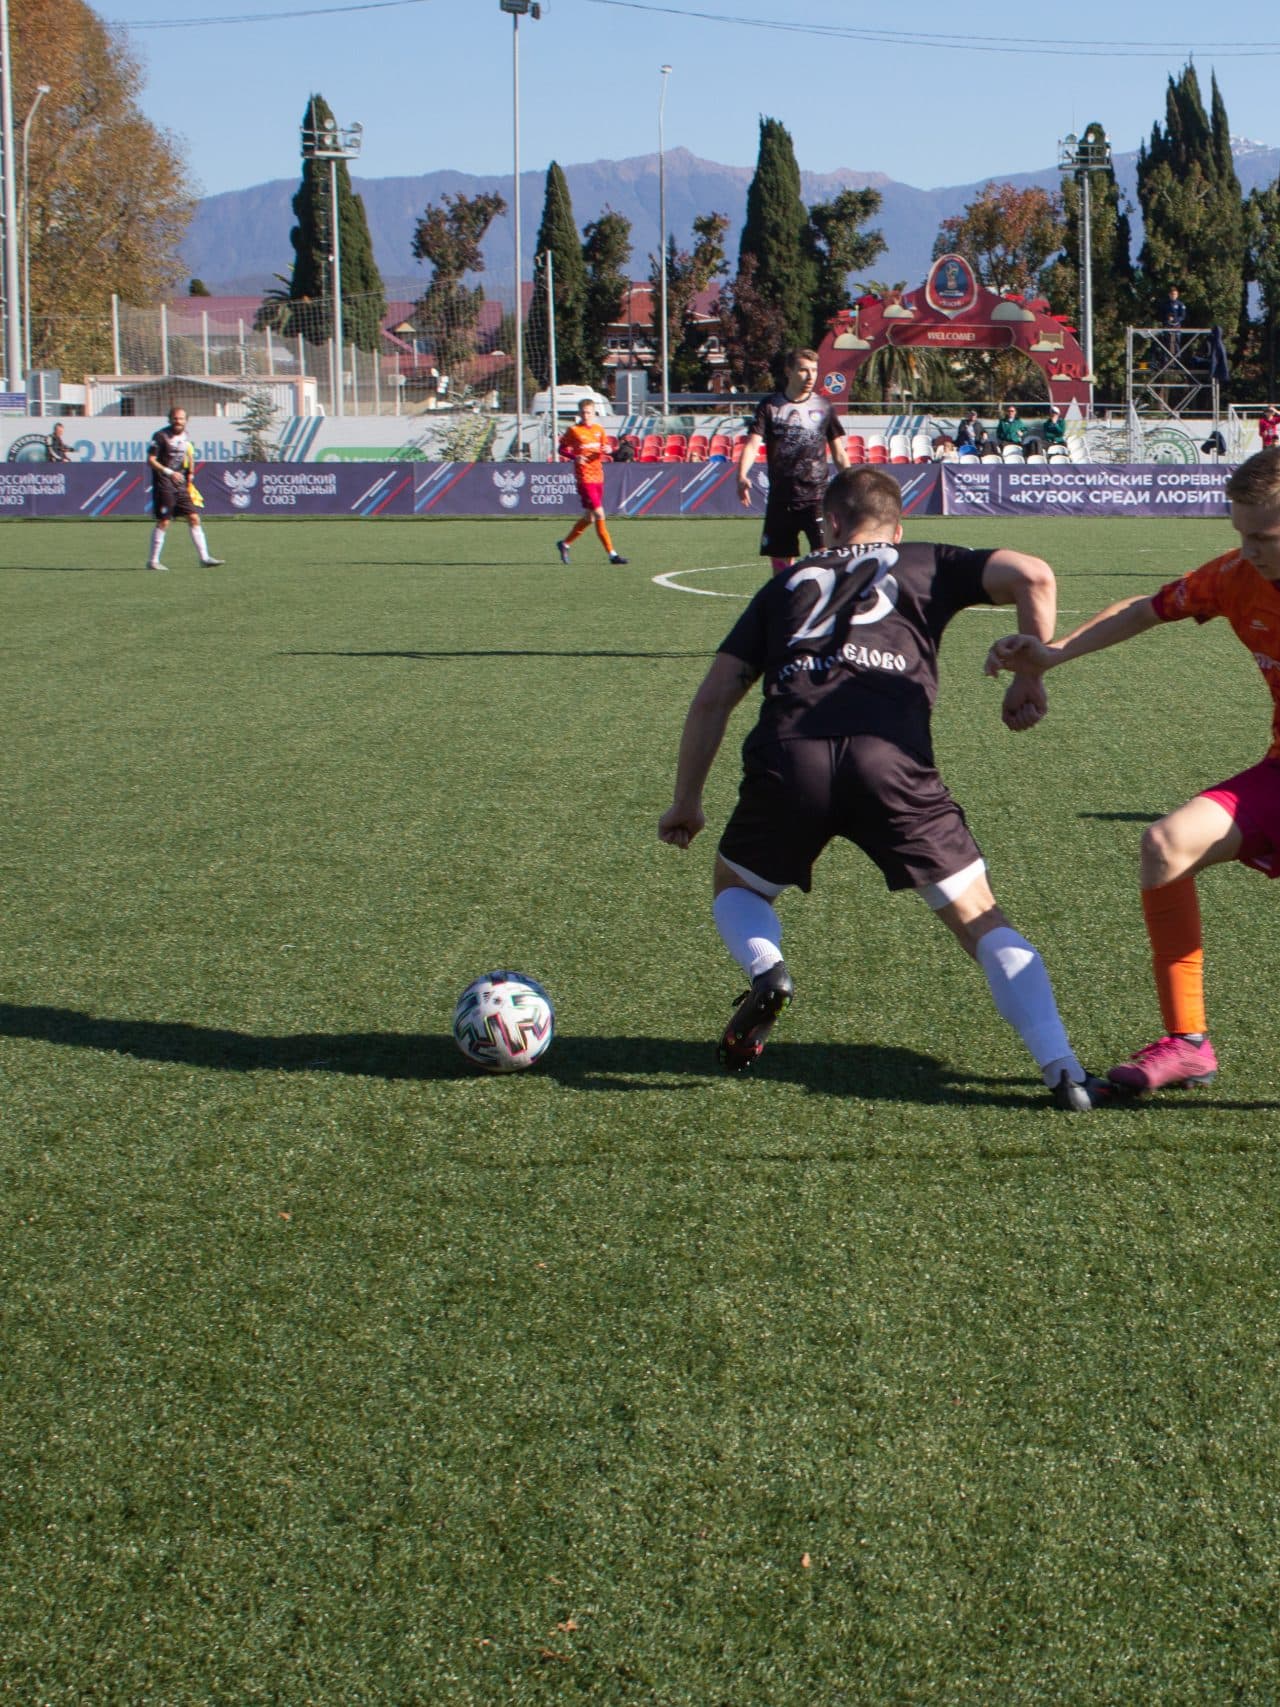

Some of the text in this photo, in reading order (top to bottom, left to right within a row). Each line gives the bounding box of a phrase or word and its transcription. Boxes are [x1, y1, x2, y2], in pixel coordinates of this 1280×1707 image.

[262, 473, 336, 485] РОССИЙСКИЙ
[530, 473, 576, 484] РОССИЙ
[954, 474, 990, 484] СОЧИ
[1009, 472, 1153, 485] ВСЕРОССИЙСКИЕ
[262, 485, 336, 495] ФУТБОЛЬНЫЙ
[262, 496, 296, 505] СОЮЗ
[530, 495, 563, 505] СОЮЗ
[954, 492, 990, 504] 2021
[1010, 490, 1084, 503] «КУБОК
[1089, 490, 1150, 505] СРЕДИ
[784, 547, 899, 648] 23
